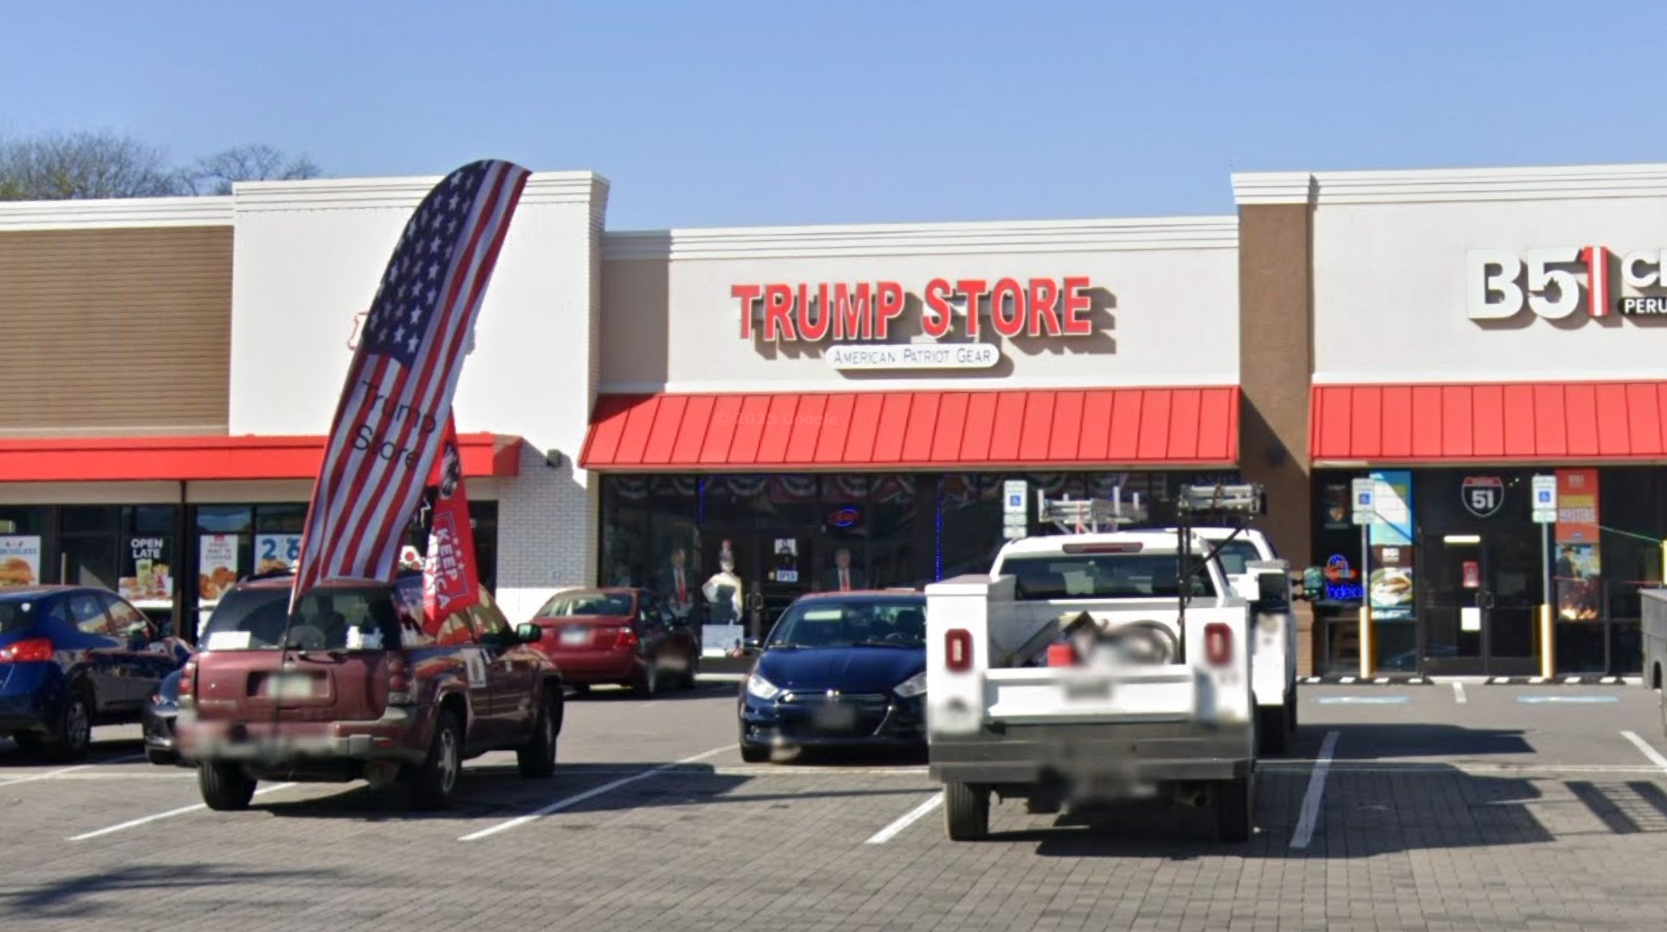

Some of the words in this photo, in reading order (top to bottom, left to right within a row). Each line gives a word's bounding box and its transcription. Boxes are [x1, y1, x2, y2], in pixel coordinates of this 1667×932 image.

[1465, 246, 1610, 319] B51
[1621, 248, 1667, 288] C
[731, 281, 905, 341] TRUMP
[921, 276, 1092, 338] STORE
[833, 348, 897, 364] AMERICAN
[902, 348, 951, 363] PATRIOT
[957, 347, 992, 363] GEAR
[362, 380, 436, 437] Trump
[353, 424, 420, 469] Store
[1471, 490, 1495, 509] 51
[131, 538, 163, 549] OPEN
[132, 549, 161, 558] LATE
[261, 538, 277, 559] 2
[437, 527, 458, 580] KEEP
